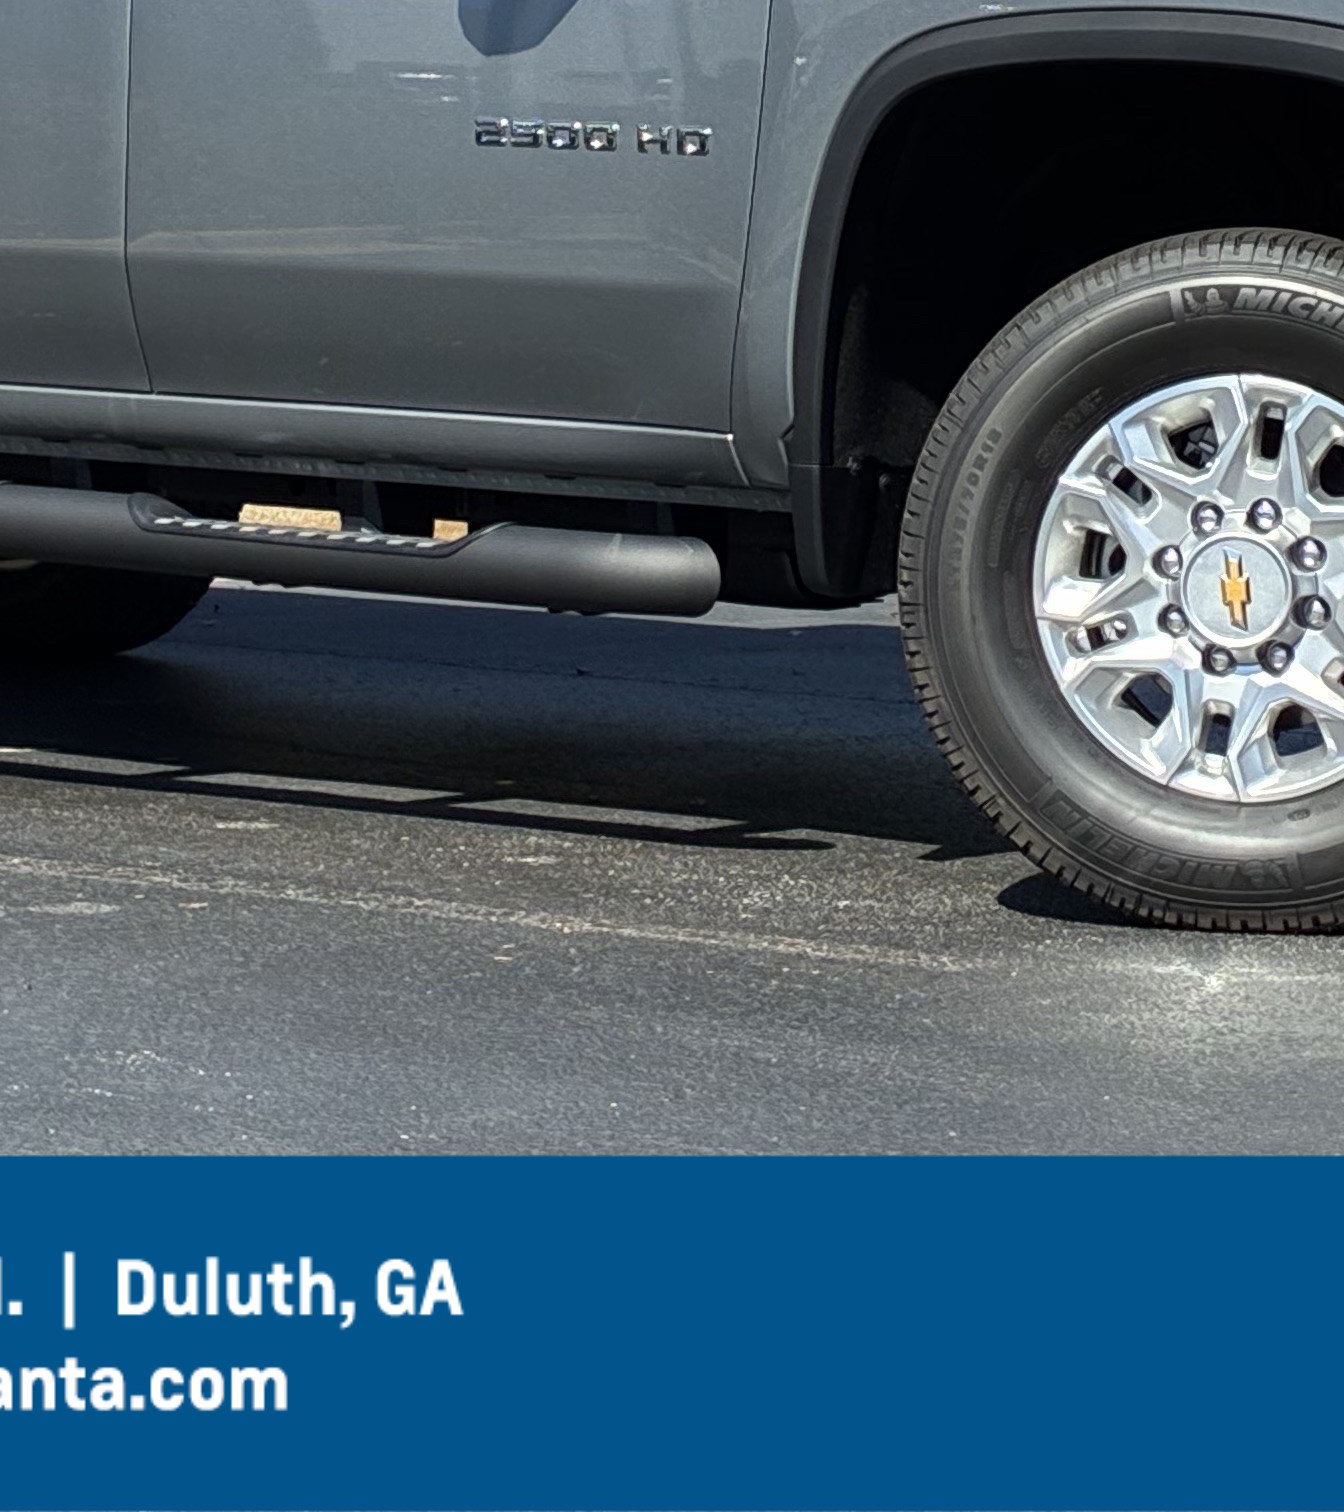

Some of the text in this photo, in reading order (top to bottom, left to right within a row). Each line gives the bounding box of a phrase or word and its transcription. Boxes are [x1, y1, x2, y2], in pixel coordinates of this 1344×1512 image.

[474, 116, 714, 157] 2500 HD
[1040, 799, 1239, 890] MICHELIN
